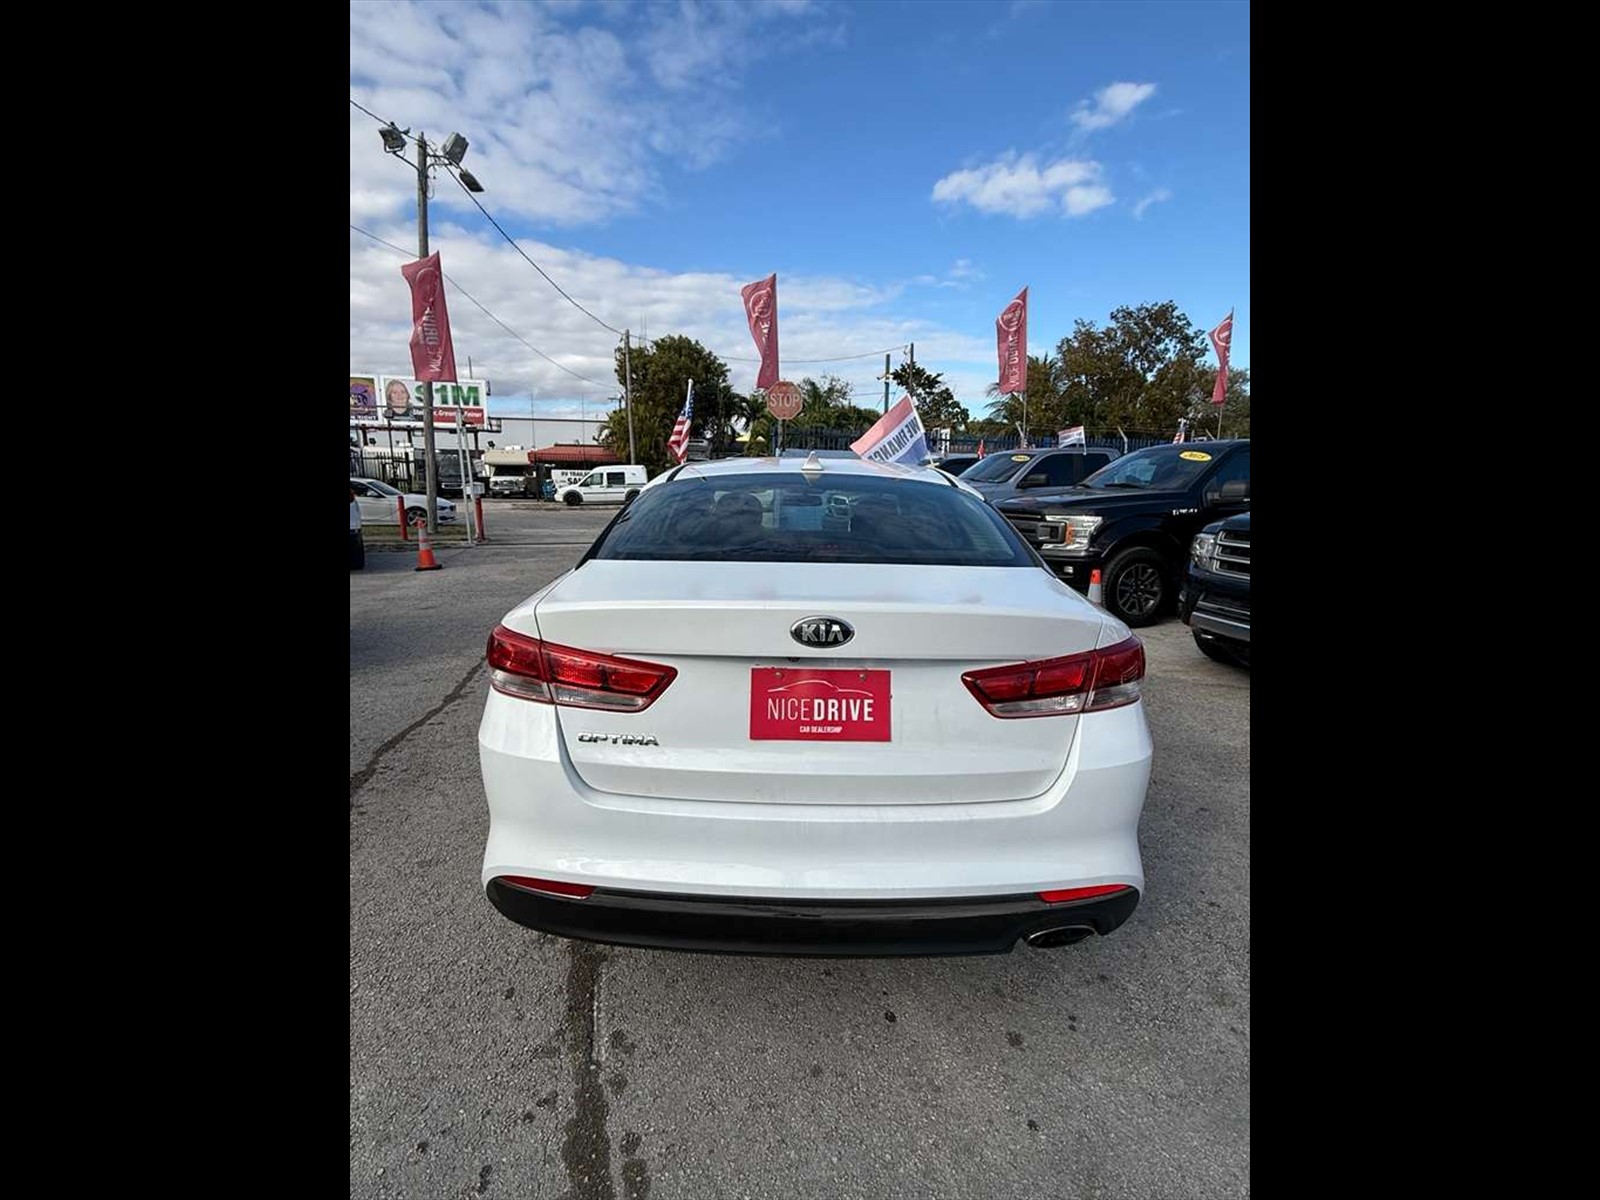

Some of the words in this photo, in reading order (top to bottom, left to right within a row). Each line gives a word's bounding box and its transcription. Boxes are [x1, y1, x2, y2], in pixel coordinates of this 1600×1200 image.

[769, 393, 801, 407] STOP
[801, 623, 845, 642] KIA
[799, 725, 811, 734] CAR
[577, 732, 660, 747] OPTIMA
